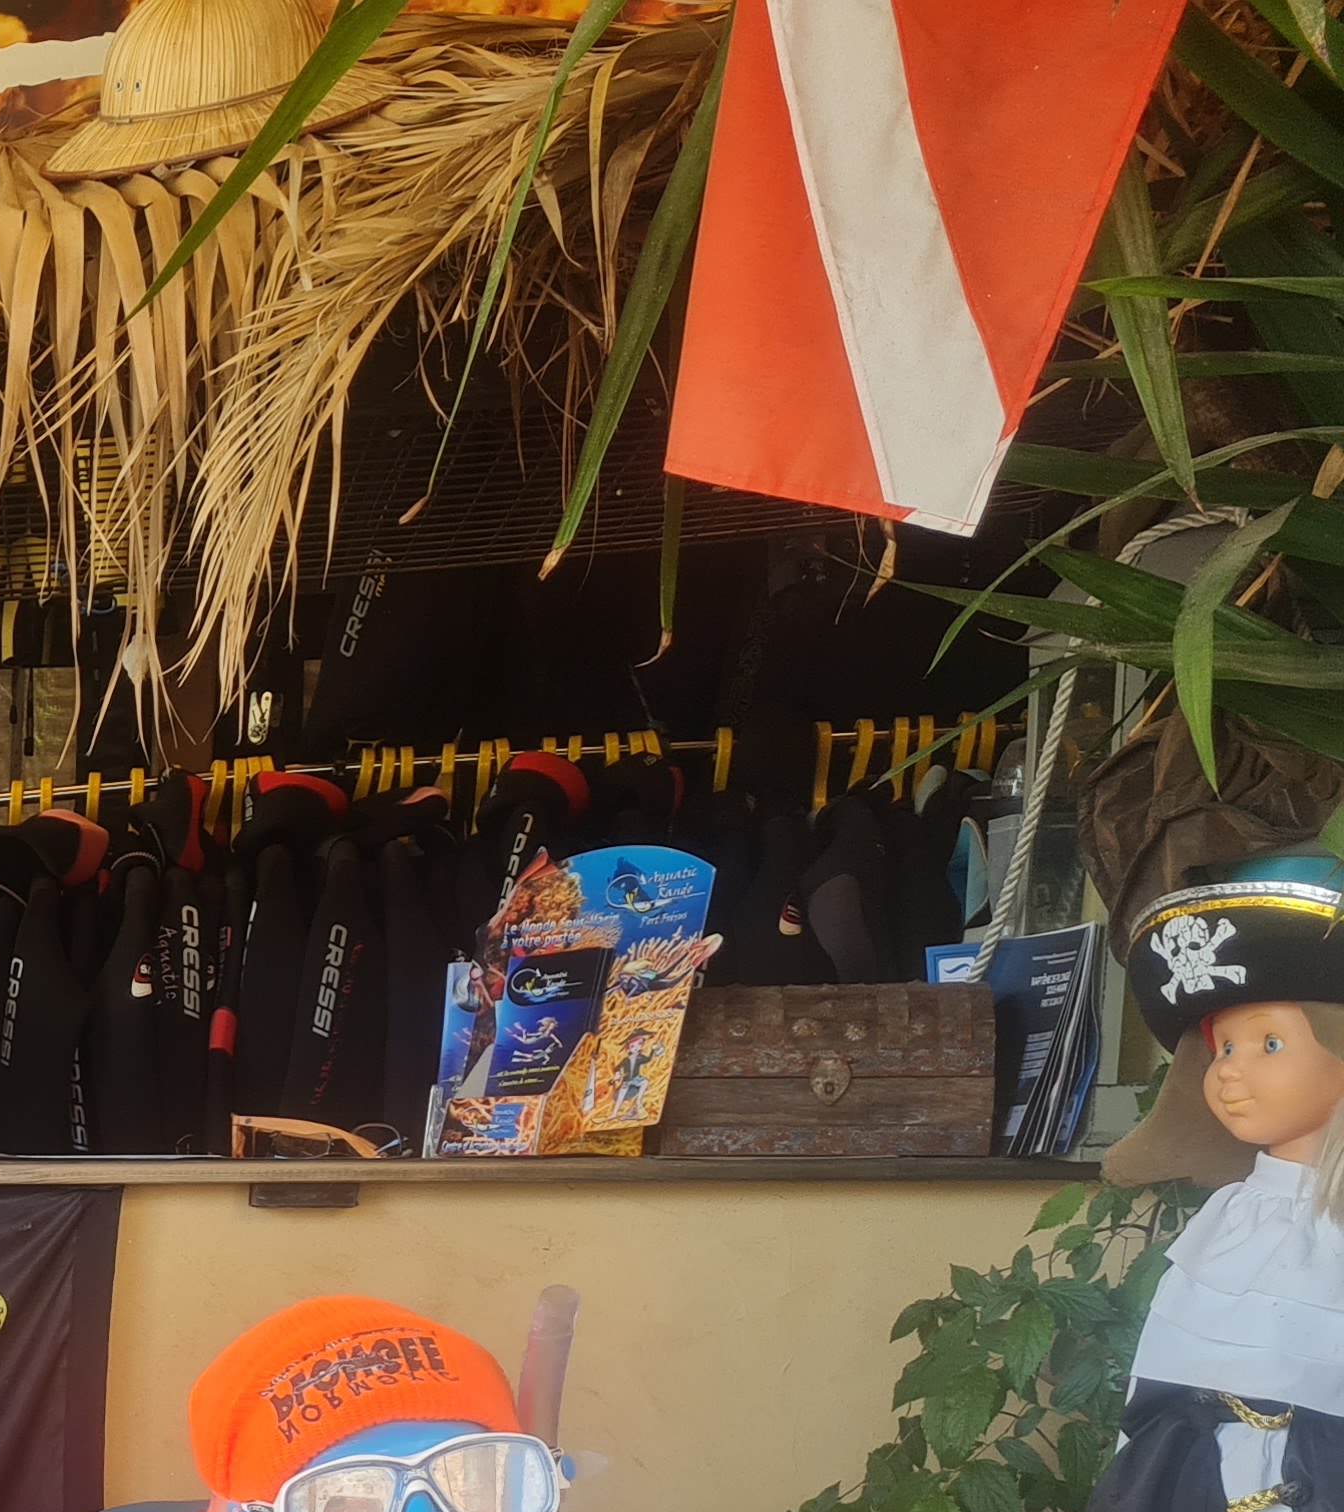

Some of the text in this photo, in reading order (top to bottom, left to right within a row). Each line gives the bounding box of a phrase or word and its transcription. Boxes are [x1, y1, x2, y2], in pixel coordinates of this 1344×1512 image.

[0, 957, 23, 1066] CRESSI
[181, 904, 200, 1019] CRESSI
[312, 924, 348, 1038] CRESSI
